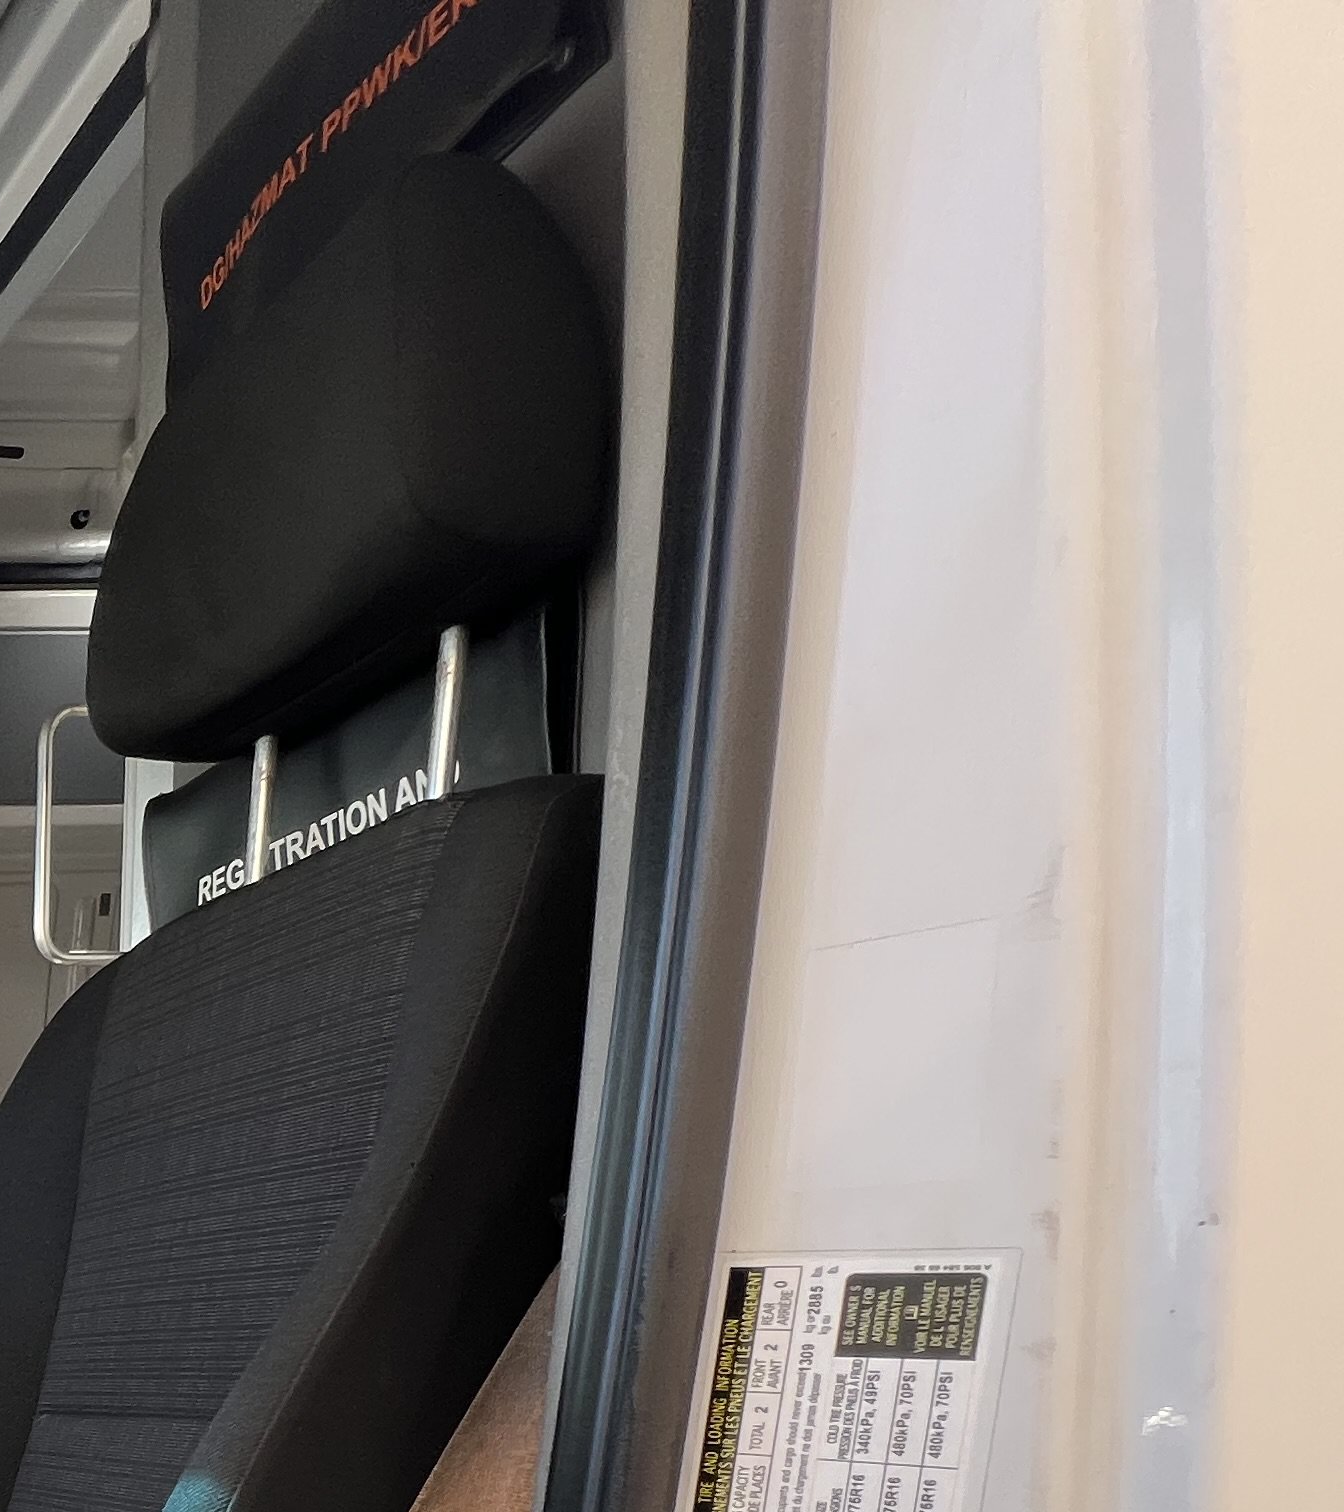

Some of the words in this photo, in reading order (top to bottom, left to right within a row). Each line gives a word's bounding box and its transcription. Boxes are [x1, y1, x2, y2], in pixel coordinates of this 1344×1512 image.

[200, 132, 315, 311] DG/HAZMAT
[197, 787, 388, 906] REGTRATION
[774, 1280, 788, 1288] 0
[862, 1286, 877, 1305] FOR
[920, 1279, 937, 1317] MANUEL
[953, 1284, 967, 1298] DE
[738, 1271, 763, 1343] CHARGEMENT
[761, 1302, 775, 1326] REAR
[871, 1288, 891, 1343] ADDITIONAL
[885, 1285, 906, 1347] INFORMATION
[948, 1298, 965, 1323] PLUS
[959, 1277, 984, 1356] RENSEIGNEMENTS
[798, 1343, 815, 1372] 1309
[807, 1285, 824, 1315] 2885
[841, 1327, 855, 1346] SEE
[855, 1304, 874, 1345] MANUAL
[917, 1316, 931, 1330] LE
[944, 1323, 961, 1349] POUR
[736, 1345, 752, 1360] LE
[763, 1343, 778, 1352] 2
[913, 1330, 929, 1354] VOIR
[929, 1333, 943, 1347] DE
[715, 1319, 740, 1392] INFORMATION
[733, 1360, 748, 1376] ET
[752, 1359, 767, 1388] FRONT
[766, 1359, 783, 1389] AVANT
[864, 1370, 881, 1405] 49PSI
[728, 1377, 745, 1414] PNEUS
[899, 1371, 917, 1406] 70PSI
[935, 1372, 953, 1407] 70PSI
[707, 1397, 728, 1446] LOADING
[754, 1406, 769, 1414] 2
[724, 1415, 740, 1437] LES
[748, 1422, 765, 1450] TOTAL
[826, 1424, 840, 1444] COLD
[856, 1408, 877, 1455] 340kPa,
[891, 1409, 913, 1457] 480kPa,
[926, 1410, 949, 1459] 480kPa,
[704, 1451, 719, 1475] AND
[720, 1438, 736, 1460] SUR
[698, 1481, 714, 1504] TIRE
[731, 1465, 751, 1508] CAPACITY
[749, 1465, 767, 1501] PLACES
